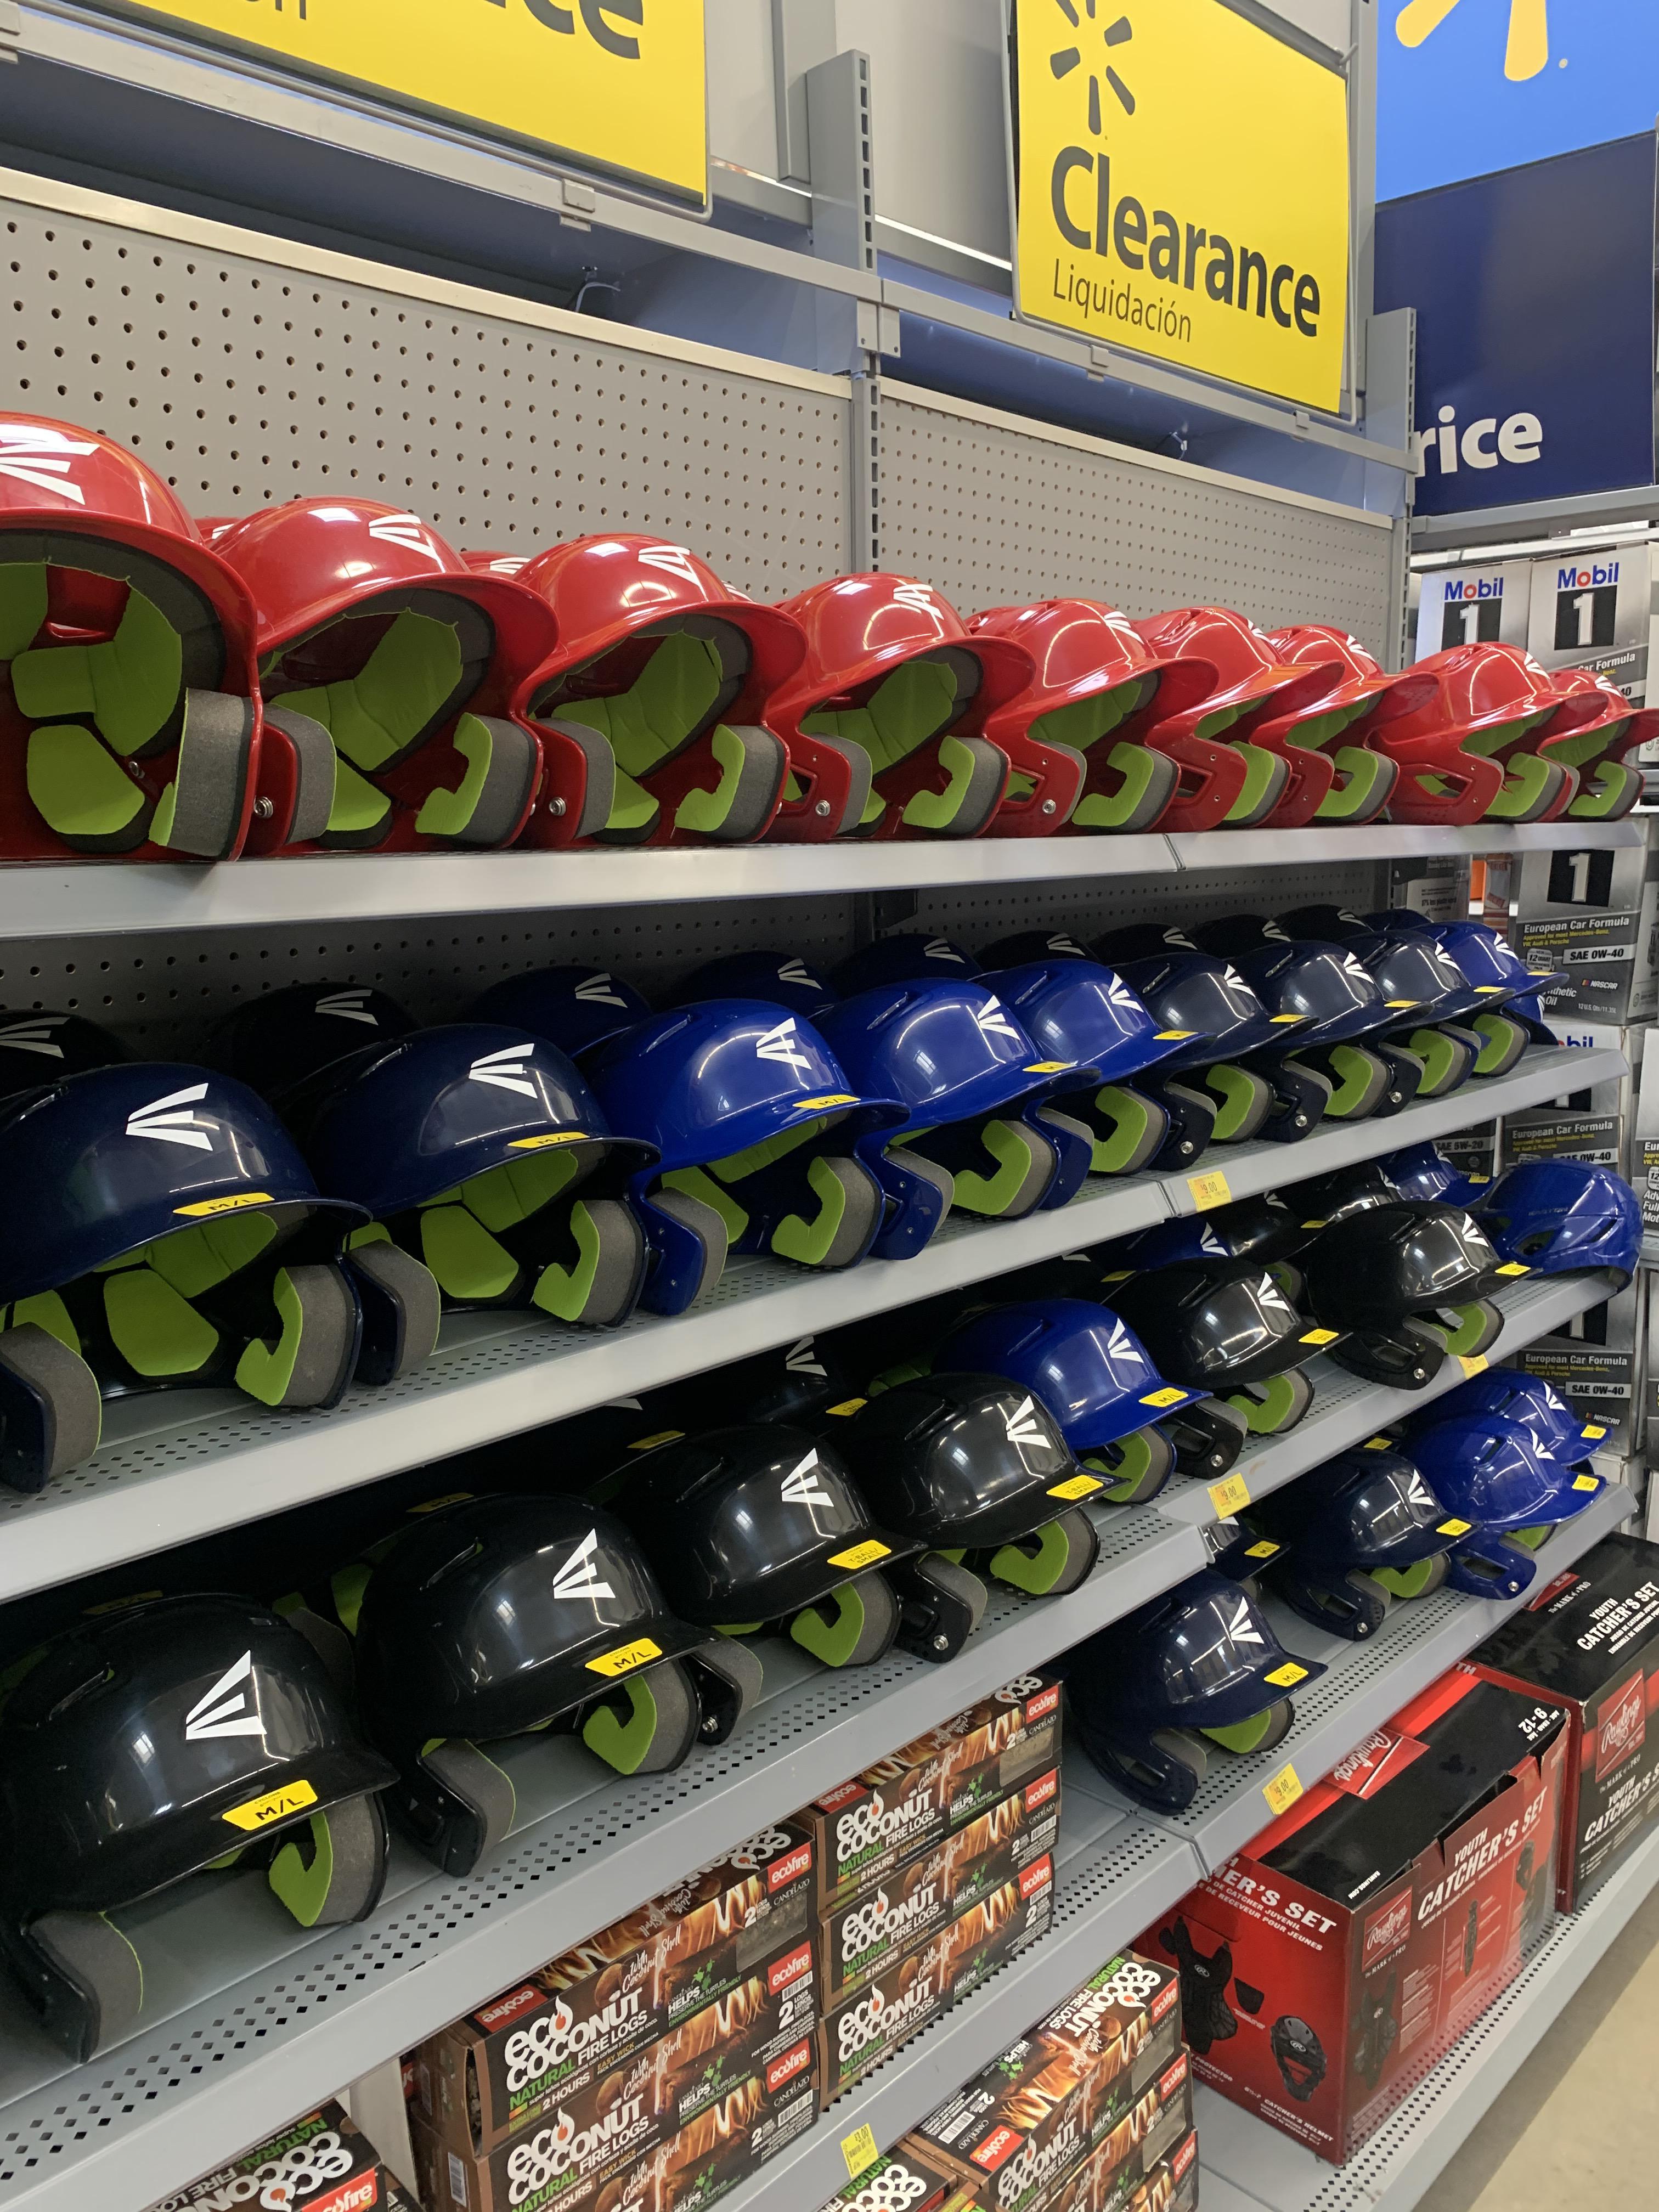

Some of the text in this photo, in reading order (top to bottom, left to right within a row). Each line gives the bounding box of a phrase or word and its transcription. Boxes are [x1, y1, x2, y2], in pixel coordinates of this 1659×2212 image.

[1051, 146, 1320, 337] Clearance
[1053, 258, 1191, 342] Liquidación
[1444, 577, 1503, 600] Mobil
[1558, 562, 1619, 589] Mobil
[1460, 603, 1479, 642] 1
[1573, 592, 1594, 645] 1
[1596, 653, 1635, 670] Formula
[1569, 853, 1590, 901] 1
[1524, 917, 1629, 934] European Car Formula
[1570, 949, 1624, 961] SAE 0W-40
[1590, 980, 1618, 990] NASCAR
[1545, 996, 1558, 1006] Oil
[1513, 1121, 1613, 1138] European Car Formula
[1436, 1141, 1452, 1150] SAE
[1526, 1354, 1627, 1365] European Car Formula
[1159, 1394, 1181, 1403] M/L
[1572, 1385, 1624, 1395] SAE 0W-40
[1594, 1414, 1620, 1425] NASCAR
[857, 1552, 882, 1564] SMALL
[1578, 1581, 1592, 1592] PRO
[1577, 1581, 1659, 1650] CATCHER'S SET
[1589, 1598, 1618, 1621] YOUTH
[613, 1652, 652, 1668] M/L
[1282, 1672, 1302, 1682] M/L
[1006, 1734, 1016, 1750] 2
[950, 1794, 973, 1814] HELPS
[1584, 1771, 1652, 1842] CATCHER'S
[1609, 1775, 1636, 1808] YOUTH
[255, 1798, 304, 1820] M/L
[837, 1788, 932, 1862] COCONUT
[886, 1808, 935, 1847] FIRE LOGS
[837, 1841, 884, 1876] NATURAL
[1418, 1819, 1519, 1920] CATCHER'S
[1522, 1786, 1548, 1833] SET
[1454, 1827, 1488, 1866] YOUTH
[772, 1853, 809, 1883] ecofire
[867, 1854, 894, 1877] HOURS
[744, 1906, 757, 1928] 2
[1025, 1905, 1037, 1928] 2
[1206, 1886, 1323, 1951] DE RECEVEUR POUR JEUNES
[1213, 1881, 1300, 1931] DE CATCHER JUVENIL
[1285, 1901, 1336, 1934] SET
[842, 1884, 936, 1962] COCONUT
[890, 1901, 939, 1944] FIRE LOGS
[661, 1924, 681, 1961] Shell
[843, 1937, 889, 1977] NATURAL
[772, 1954, 809, 1987] ecofire
[871, 1950, 899, 1976] HOURS
[695, 1993, 704, 2004] THE
[704, 1978, 726, 1996] TURTLES
[954, 1970, 976, 1992] HELPS
[482, 1990, 534, 2023] ecofire
[668, 1986, 701, 2014] HELPS
[1049, 1989, 1093, 2030] FIRE LOGS
[505, 1995, 573, 2066] eco
[779, 2001, 794, 2030] 2
[839, 1977, 932, 2062] COCONUT
[886, 1995, 934, 2040] FIRE LOGS
[506, 1987, 642, 2092] COCONUT
[578, 2010, 647, 2066] FIRE LOGS
[663, 2029, 682, 2065] Shell
[1004, 2040, 1029, 2063] HELPS
[597, 2041, 635, 2071] EASY WICK
[631, 2057, 648, 2083] With
[770, 2049, 807, 2083] ecofire
[866, 2045, 893, 2071] HOURS
[1195, 2057, 1233, 2082] PROTECTOR
[510, 2059, 576, 2110] NATURAL
[543, 2072, 590, 2111] 2 HOURS
[706, 2090, 715, 2100] THE
[715, 2074, 736, 2093] TURTLES
[728, 2069, 751, 2091] FRIENDLY
[774, 2076, 809, 2107] CANDELAZO
[529, 2093, 545, 2106] super
[679, 2083, 710, 2112] HELPS
[978, 2092, 995, 2105] 2
[854, 2127, 869, 2143] $3.00
[1264, 2098, 1303, 2124] CATCHER'S
[1304, 2122, 1334, 2142] HELMET
[244, 2118, 328, 2169] NATURAL
[507, 2107, 574, 2179] eco
[508, 2094, 644, 2205] COCONUT
[579, 2115, 649, 2175] FIRE LOGS
[661, 2131, 681, 2169] Shell
[752, 2127, 762, 2148] 2
[977, 2131, 1010, 2163] ecofire
[599, 2148, 636, 2179] EASY WICK
[511, 2168, 578, 2212] NATURAL
